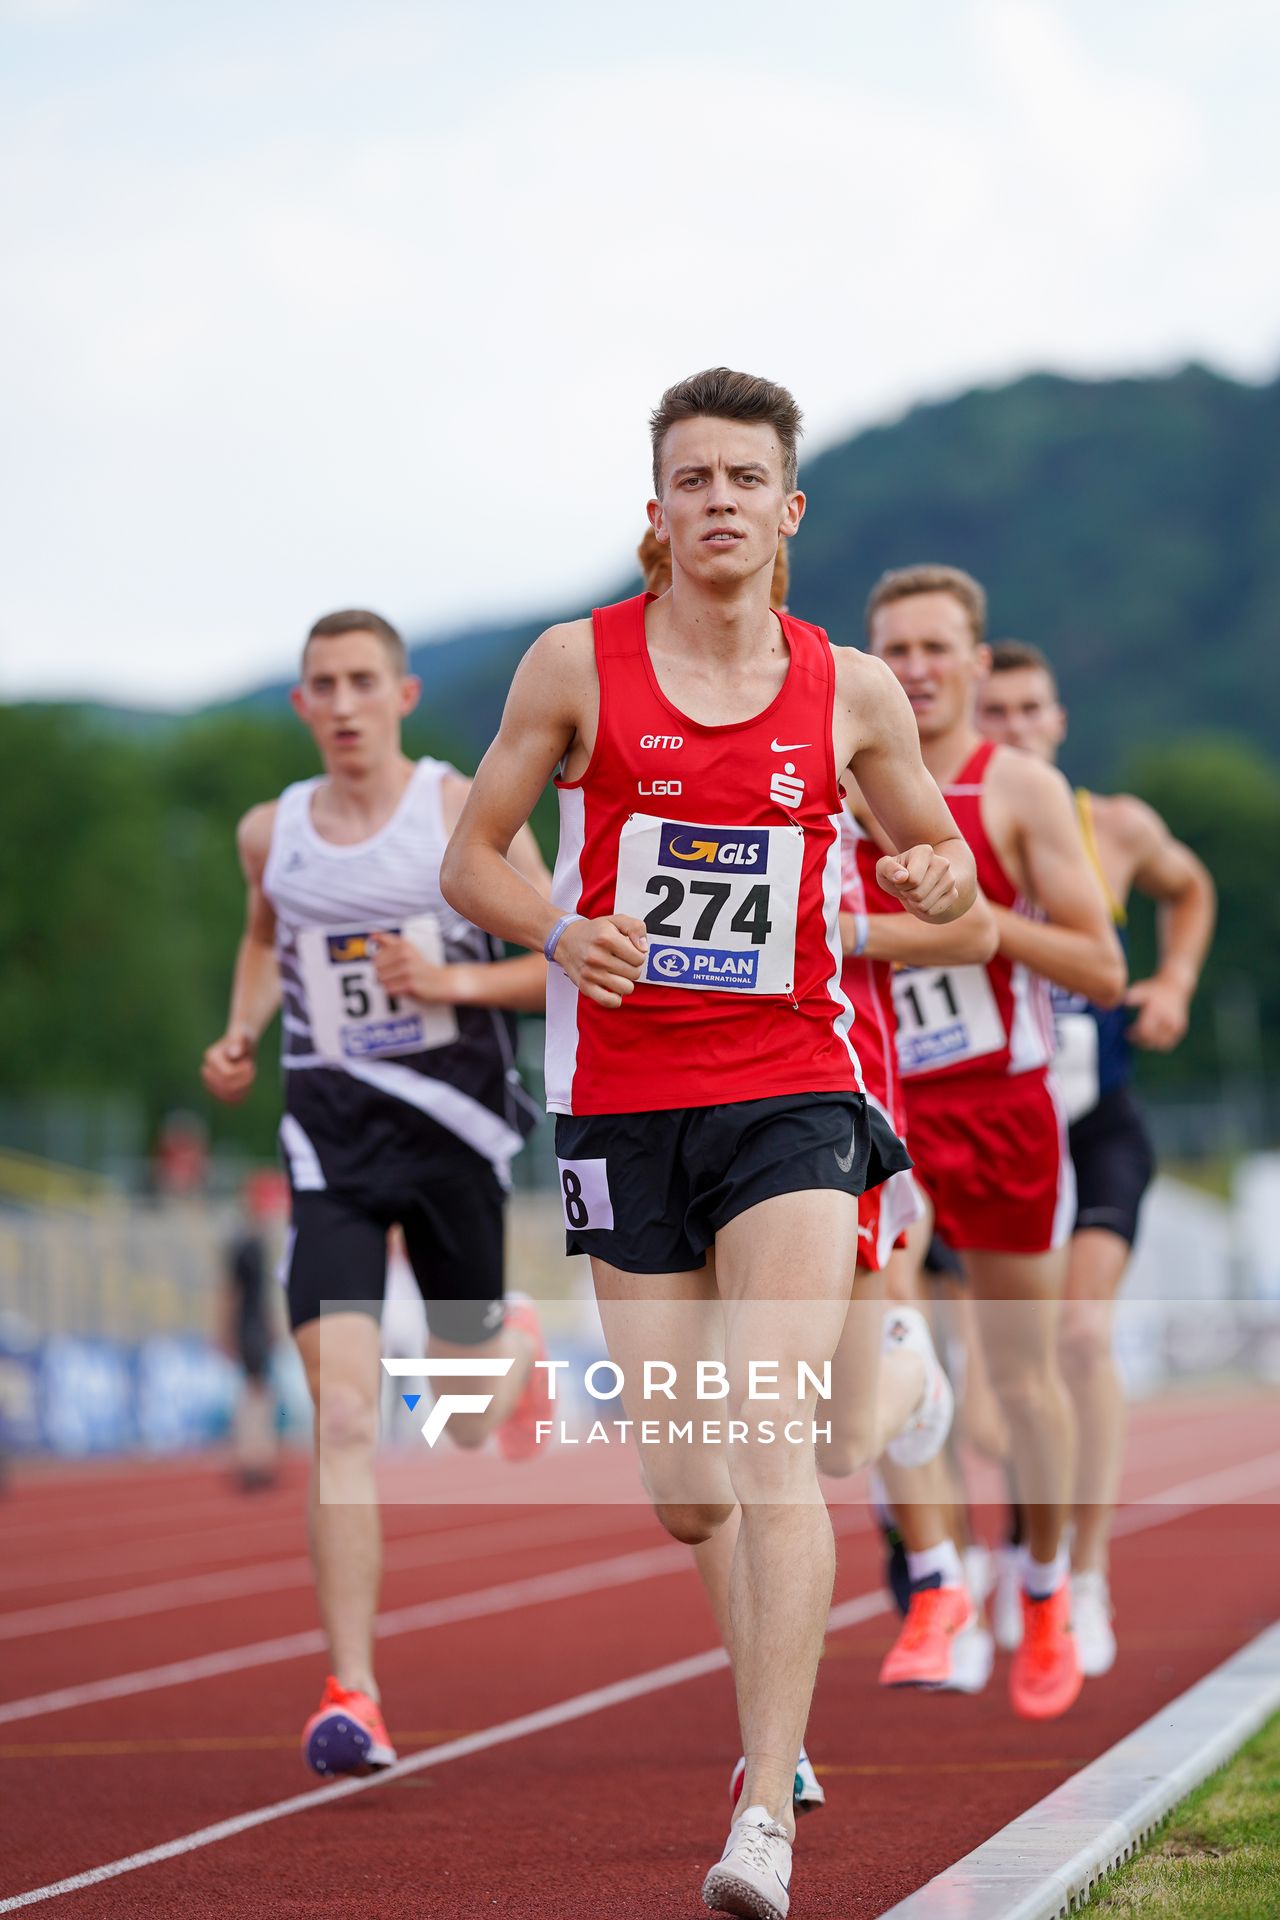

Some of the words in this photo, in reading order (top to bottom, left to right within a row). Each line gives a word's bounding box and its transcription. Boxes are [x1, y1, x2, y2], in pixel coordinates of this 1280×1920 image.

[639, 735, 684, 750] GfTD
[637, 780, 682, 796] LGO
[716, 843, 760, 866] GLS
[644, 875, 772, 944] 274
[693, 954, 754, 975] PLAN
[693, 973, 752, 984] INTERNATIONAL
[562, 1168, 589, 1228] 8
